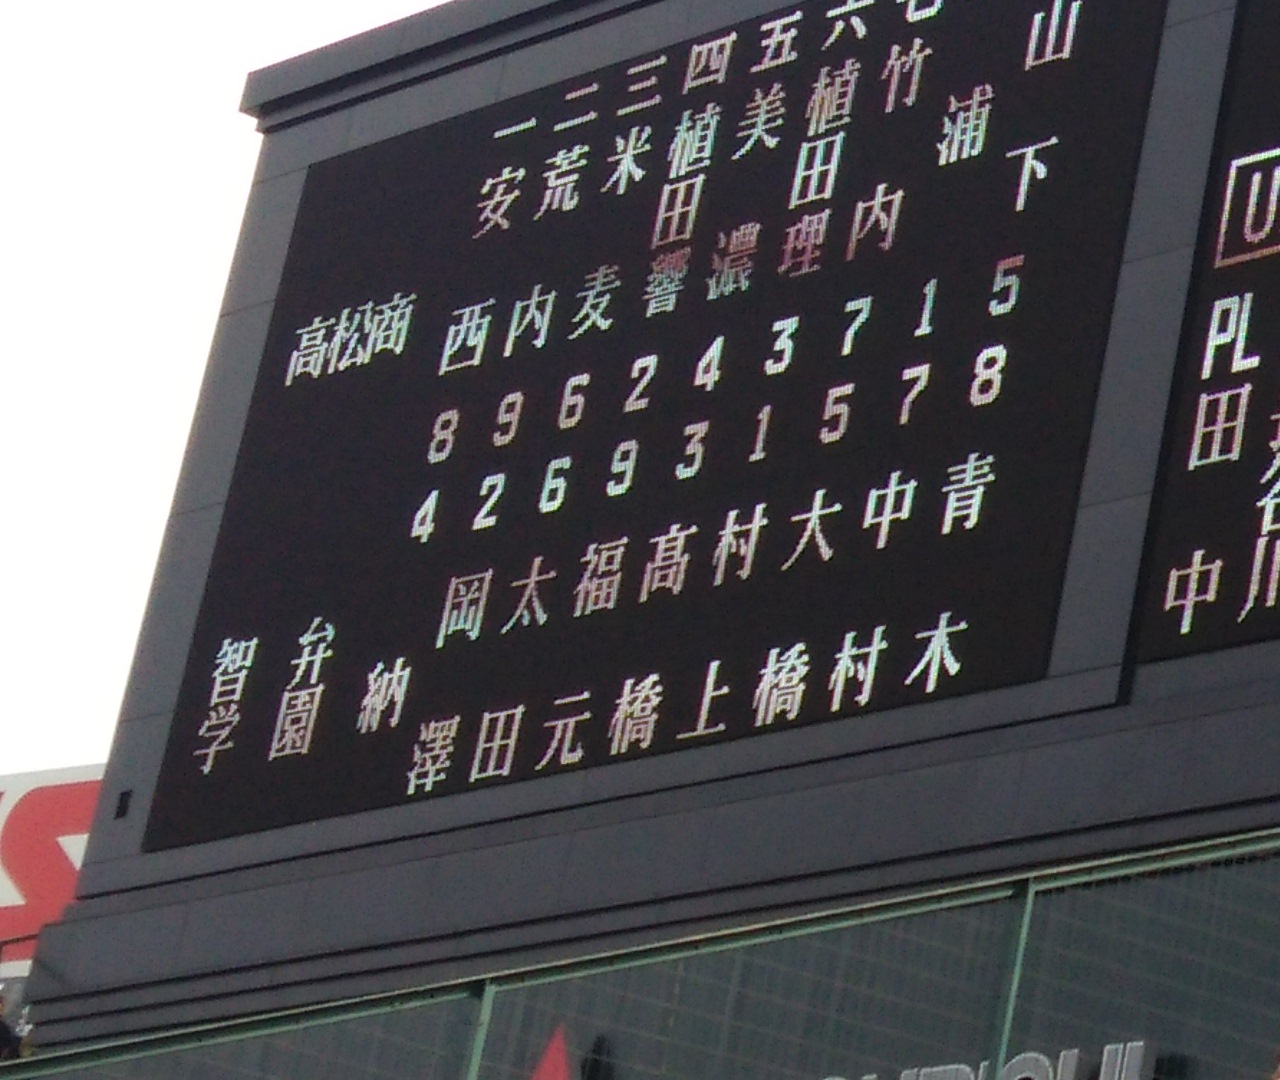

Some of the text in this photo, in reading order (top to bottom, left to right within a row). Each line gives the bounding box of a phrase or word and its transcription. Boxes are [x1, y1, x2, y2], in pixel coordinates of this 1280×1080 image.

[284, 291, 418, 387] 高松商
[1199, 291, 1262, 381] PL
